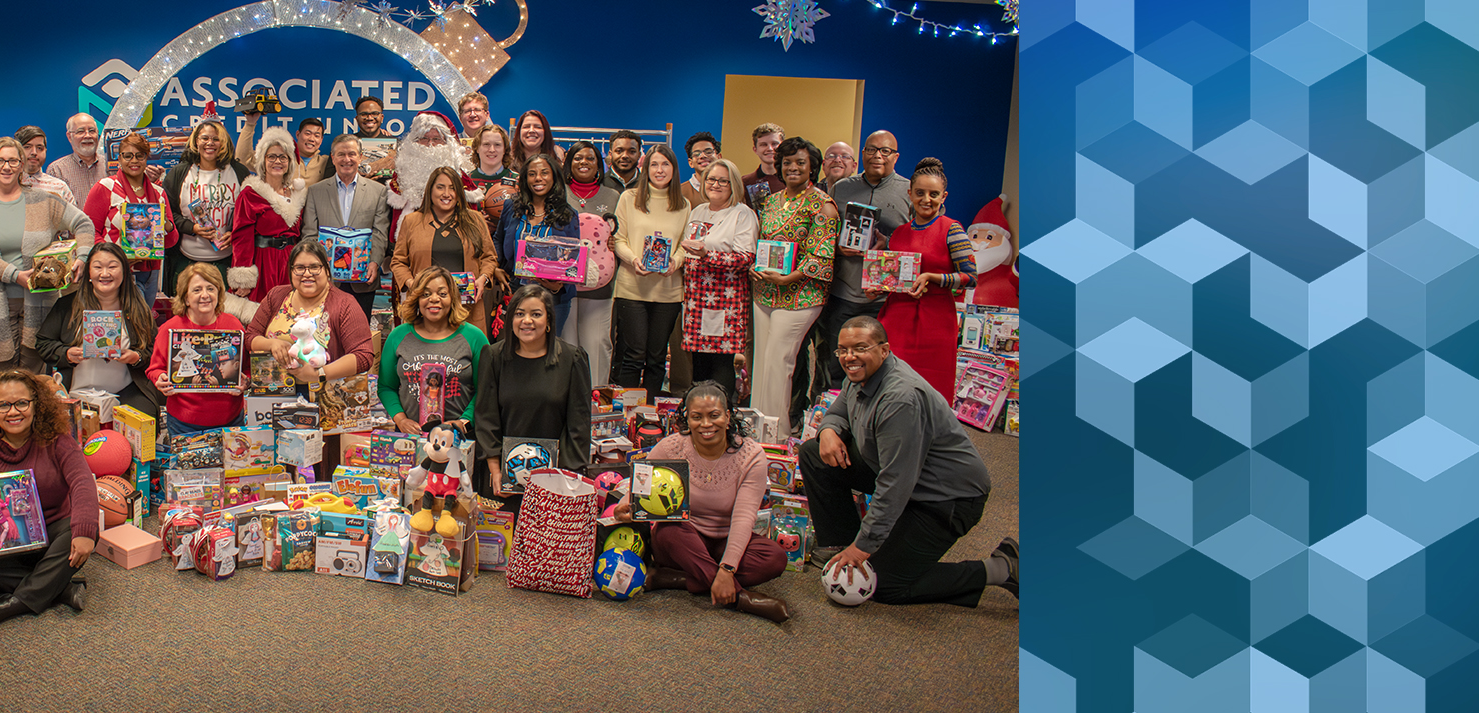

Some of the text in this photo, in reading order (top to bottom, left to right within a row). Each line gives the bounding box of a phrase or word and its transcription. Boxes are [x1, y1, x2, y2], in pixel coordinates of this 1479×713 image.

[159, 76, 436, 112] ASSOCIATED
[189, 183, 236, 204] MERRY
[441, 355, 458, 365] MOST
[336, 478, 377, 495] Elefun
[408, 574, 435, 586] SKETCH
[436, 580, 456, 590] BOOK
